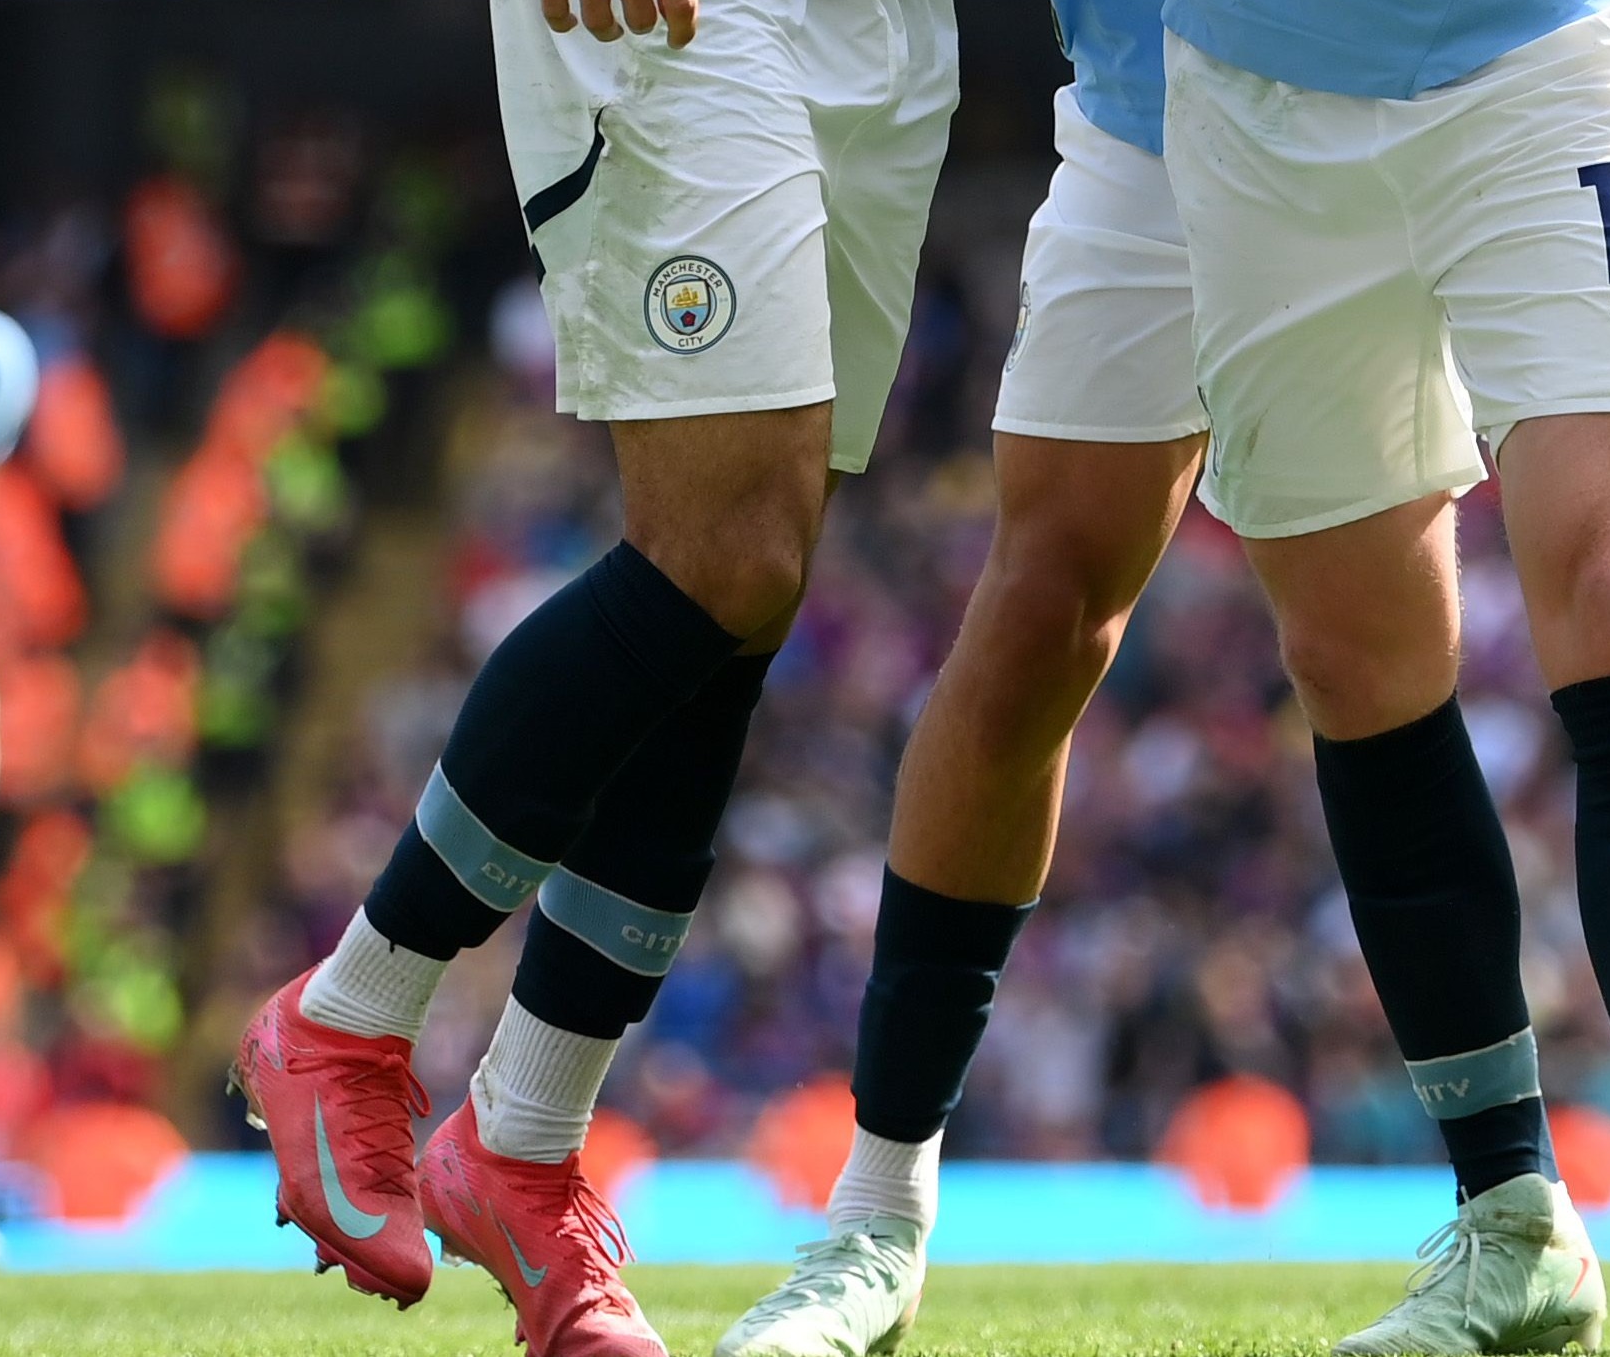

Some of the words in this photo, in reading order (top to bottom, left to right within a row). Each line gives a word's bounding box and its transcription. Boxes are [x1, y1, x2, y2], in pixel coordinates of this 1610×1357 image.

[652, 262, 723, 298] MANCHESTER
[678, 335, 704, 348] CITY
[480, 861, 541, 894] CIT
[1416, 1077, 1471, 1102] ITY
